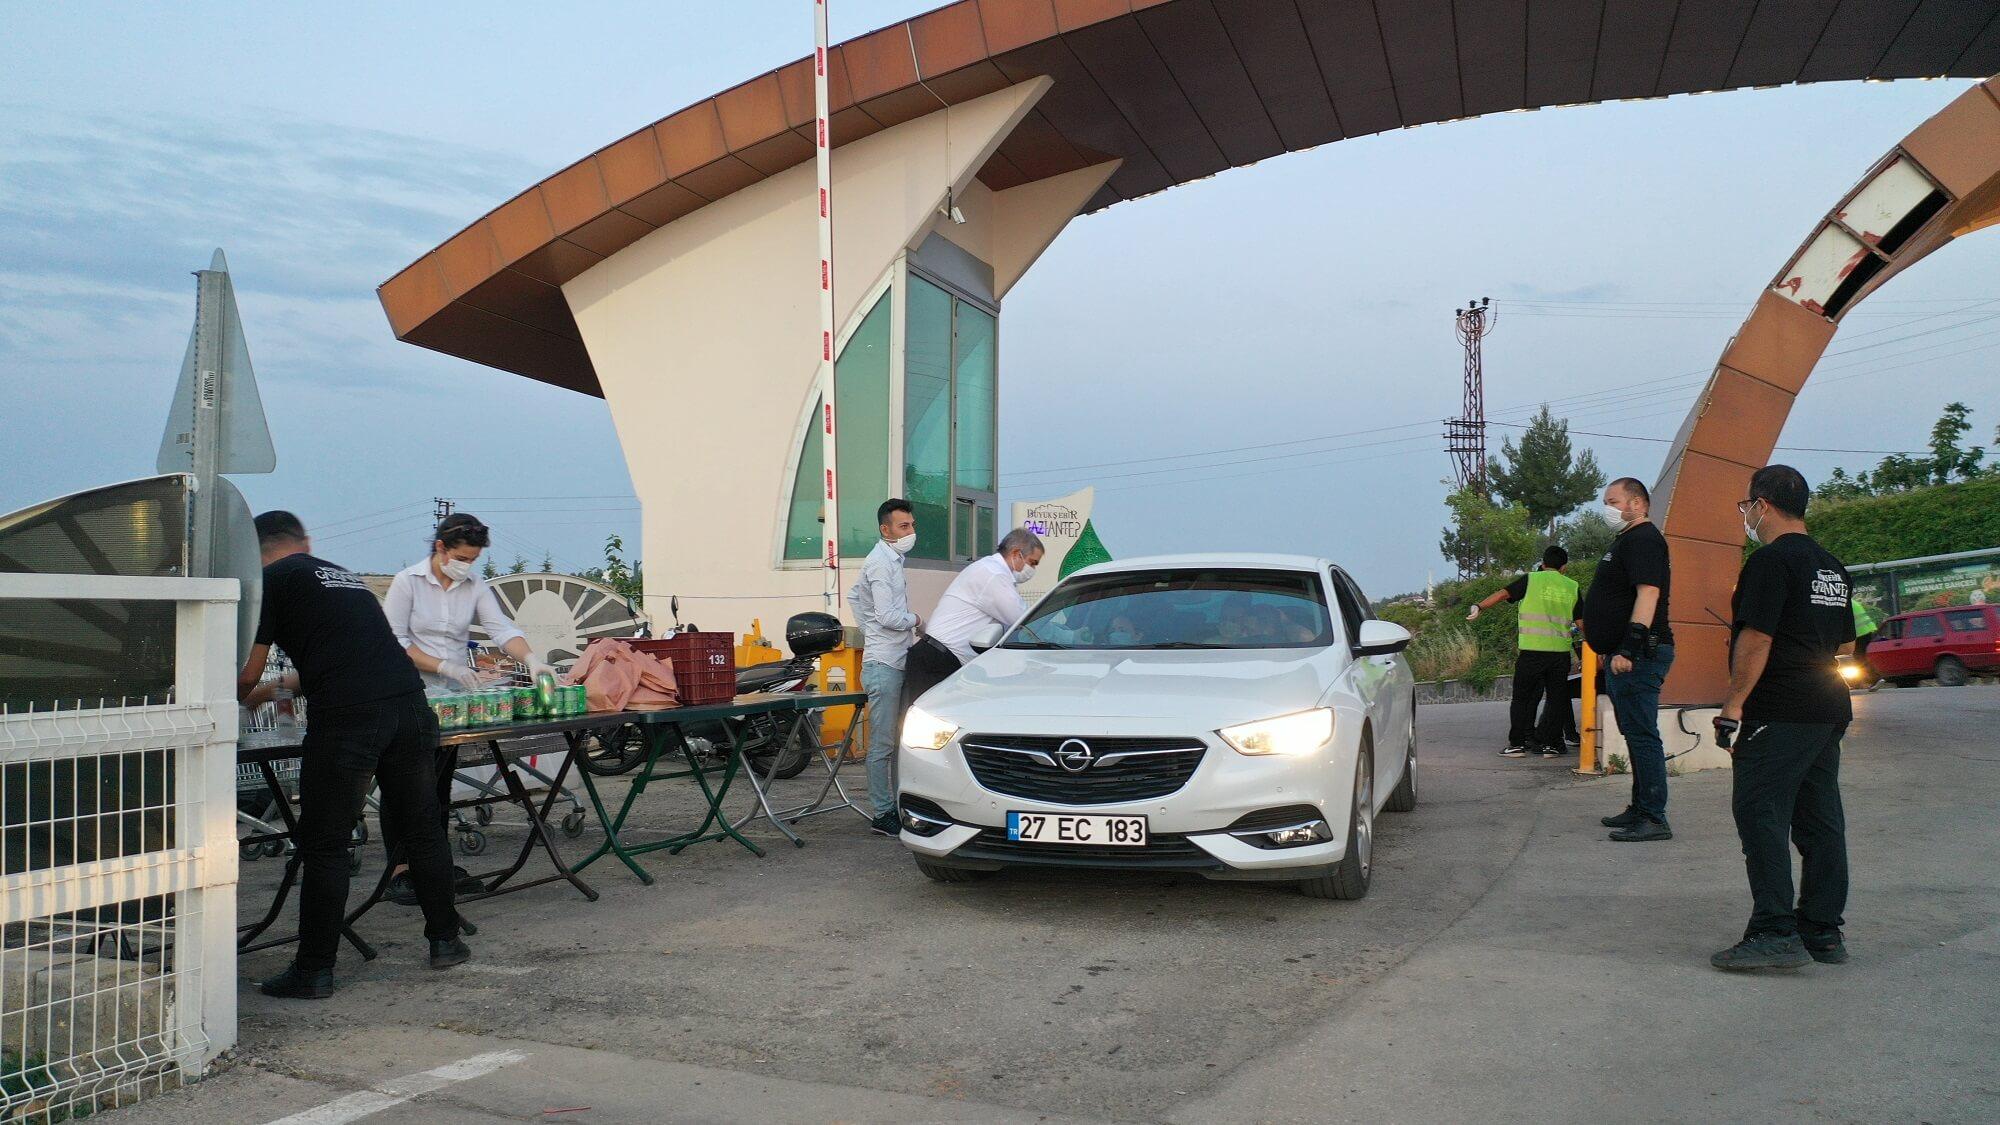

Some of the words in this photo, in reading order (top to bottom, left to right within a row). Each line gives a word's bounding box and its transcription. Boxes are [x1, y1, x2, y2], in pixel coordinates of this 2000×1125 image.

[709, 654, 725, 665] 132
[1009, 827, 1018, 836] TR
[1020, 816, 1046, 840] 27
[1058, 817, 1092, 841] EC
[1105, 819, 1143, 843] 183
